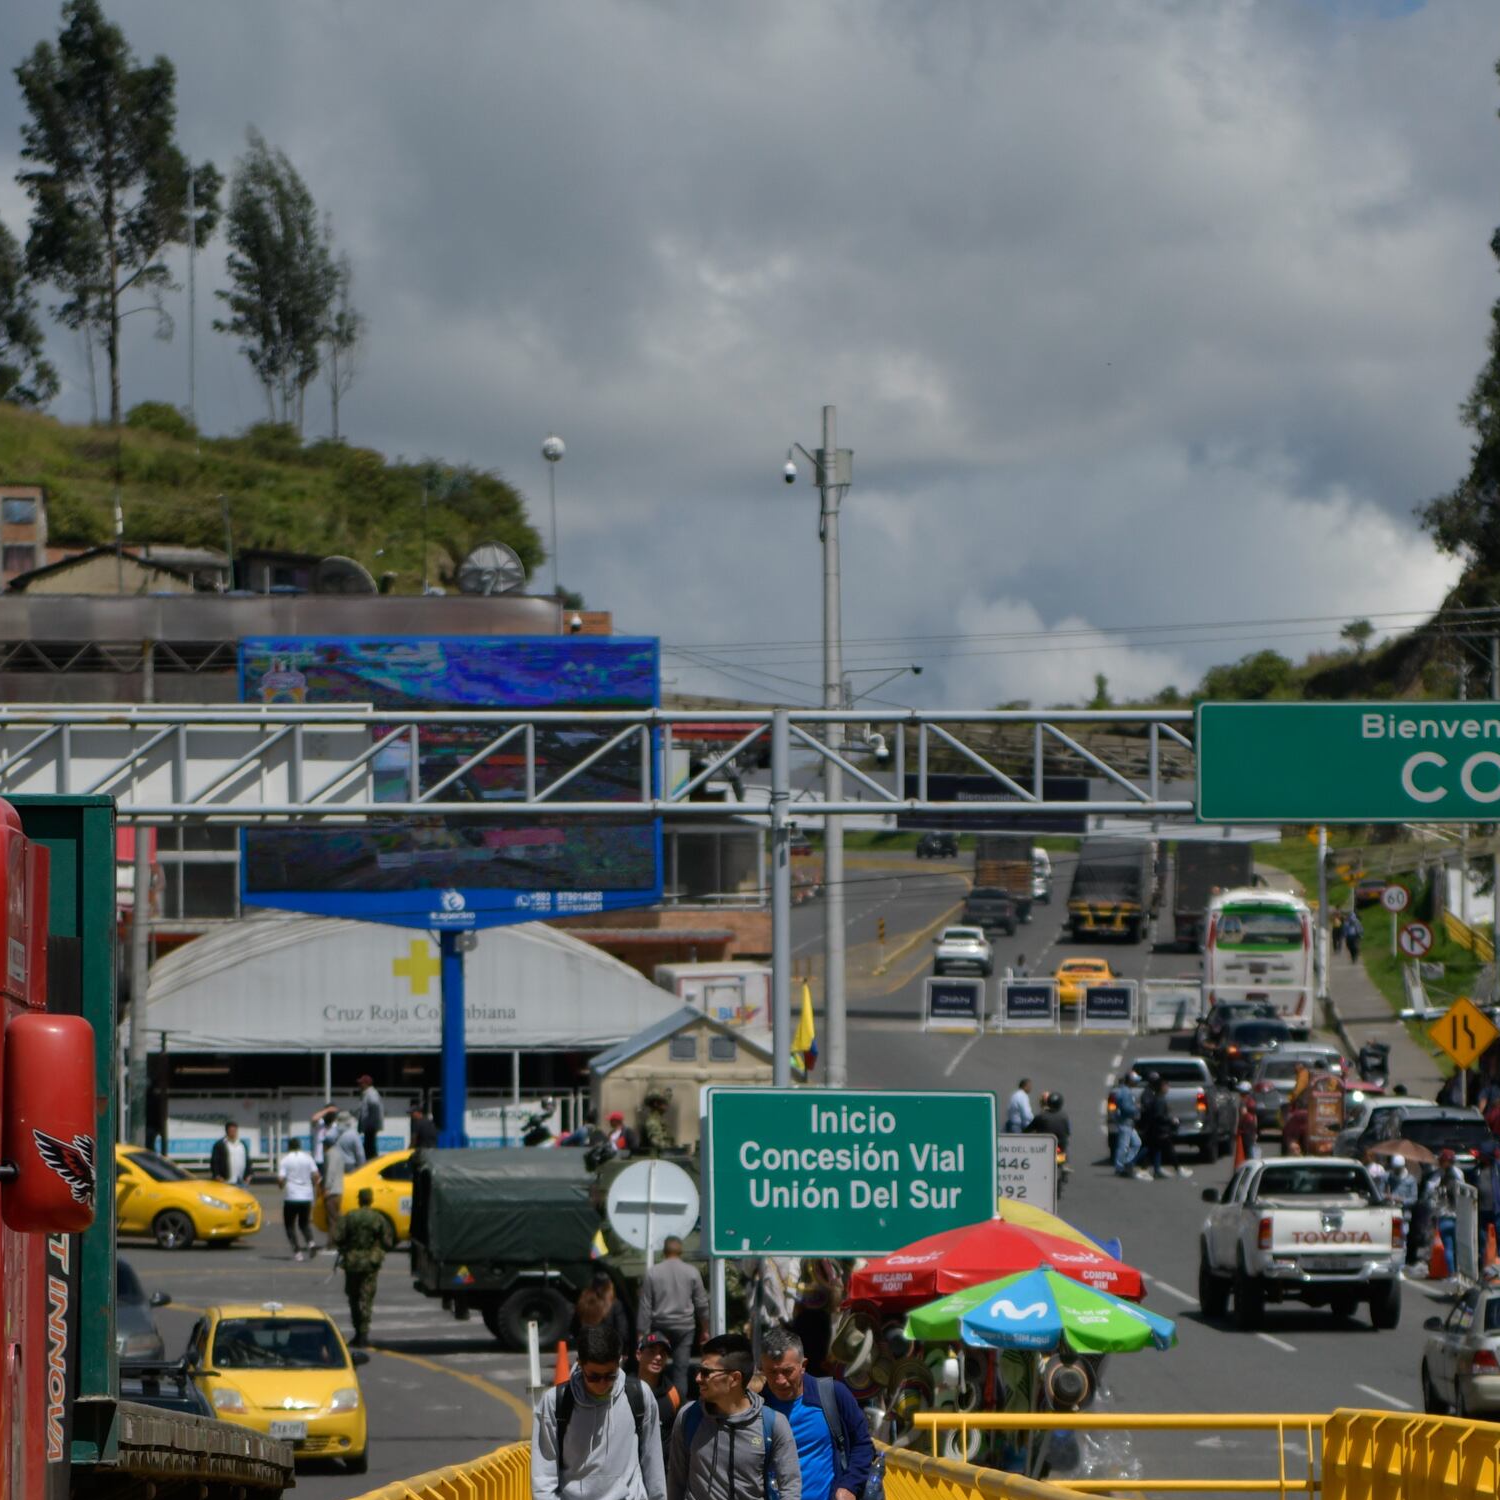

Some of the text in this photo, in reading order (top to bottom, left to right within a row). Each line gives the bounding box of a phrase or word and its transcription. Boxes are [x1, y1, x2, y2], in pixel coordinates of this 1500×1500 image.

[1387, 890, 1405, 905] 60
[323, 1004, 364, 1021] Cruz
[370, 1004, 409, 1024] Roja
[811, 1104, 896, 1134] Inicio
[739, 1141, 965, 1172] Concesión Vial
[750, 1178, 962, 1208] Unión Del Sur
[1291, 1231, 1373, 1245] TOYOTA
[872, 1273, 913, 1283] RECARGA
[1082, 1270, 1118, 1280] COMPRA
[47, 1275, 68, 1463] INNOVA
